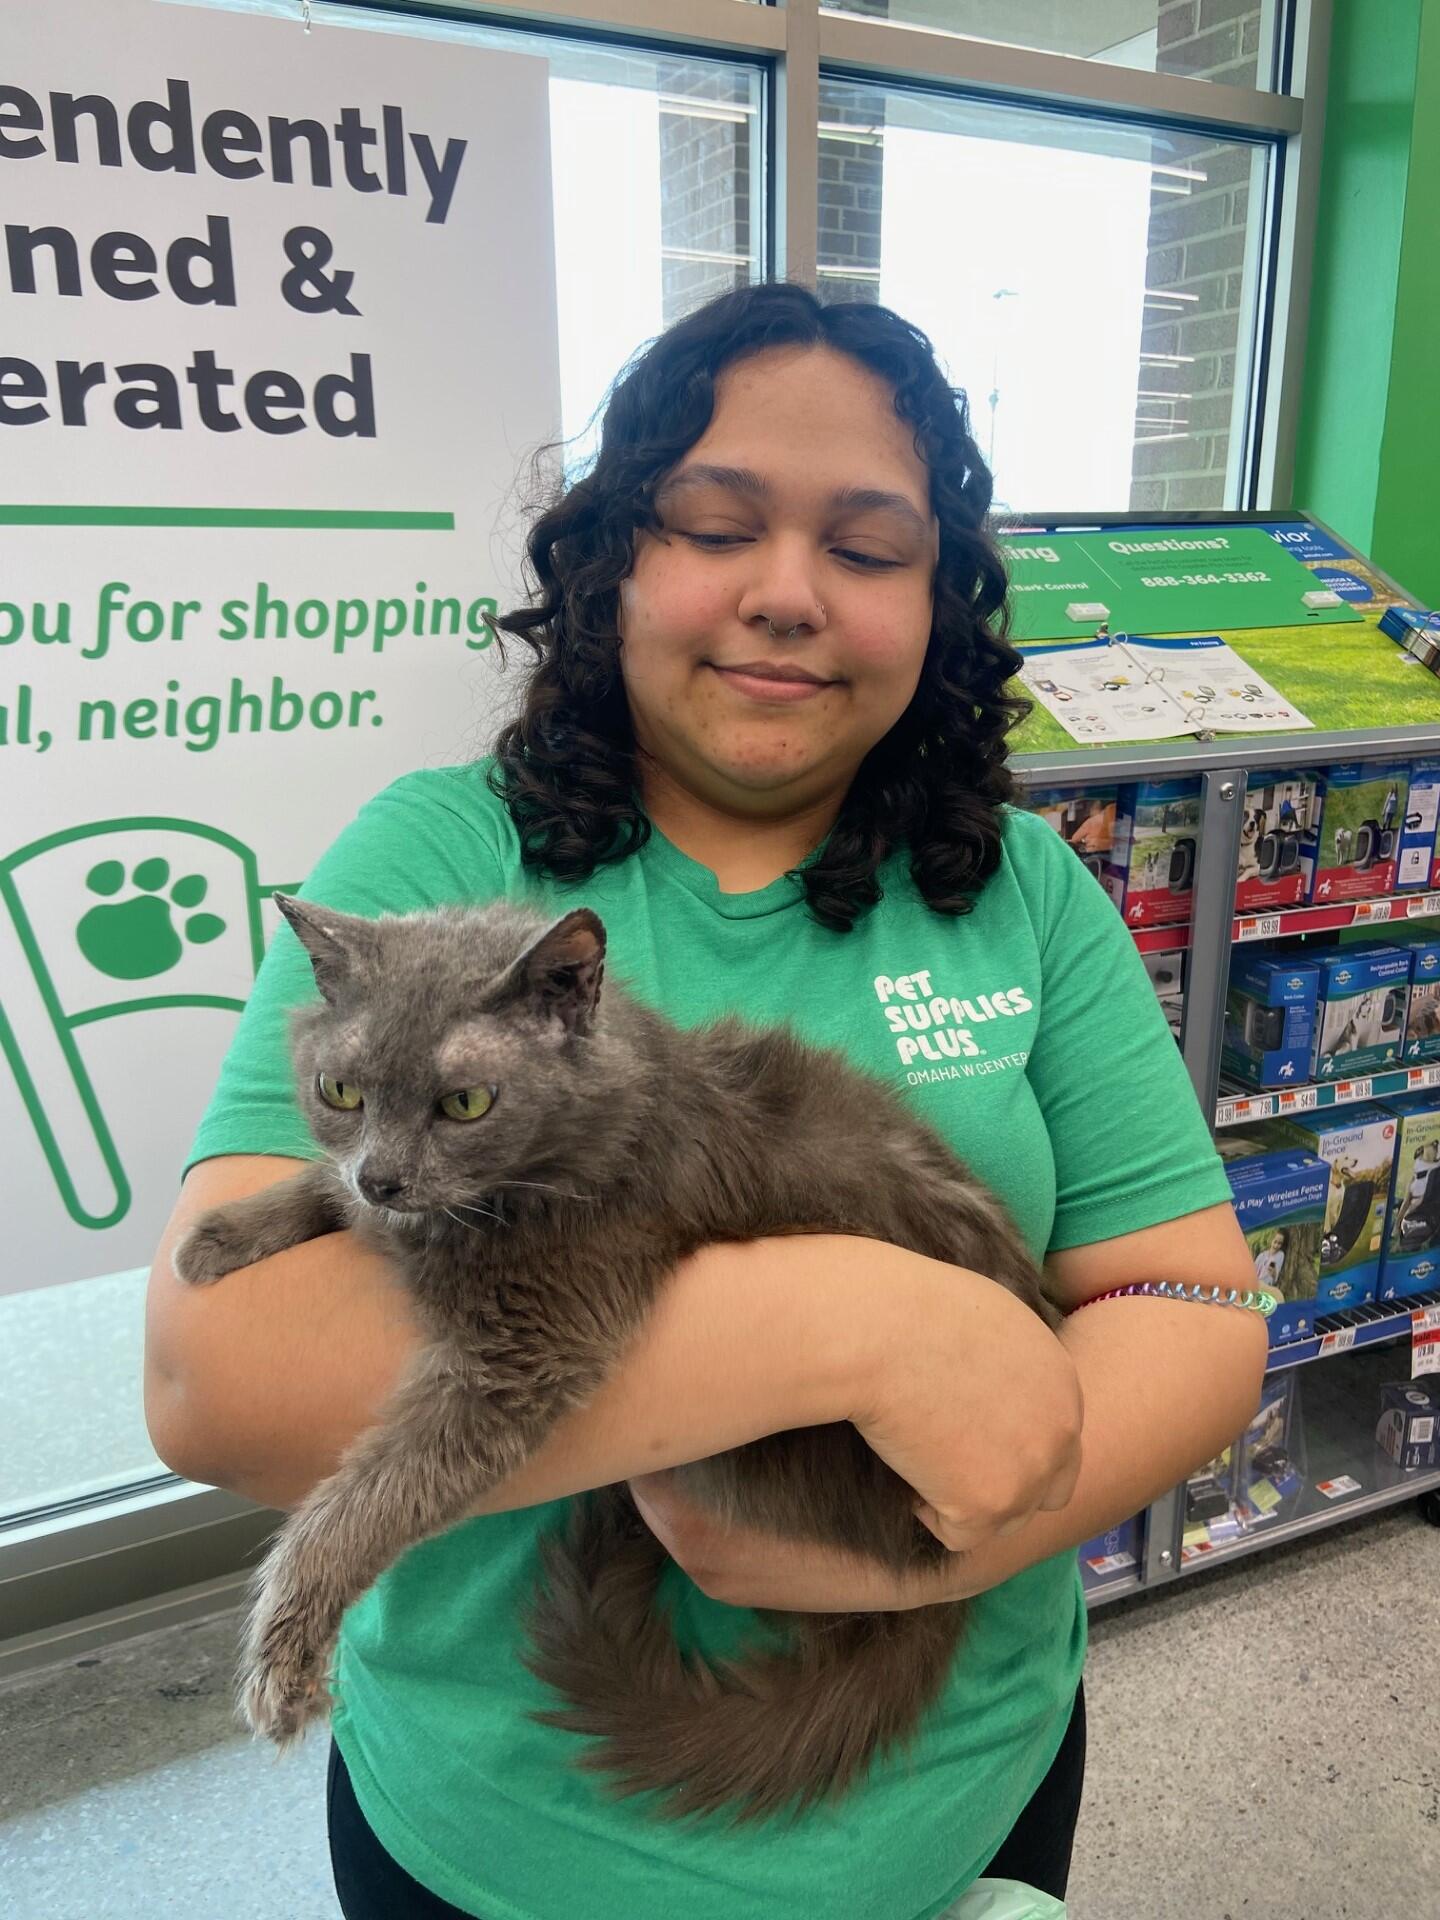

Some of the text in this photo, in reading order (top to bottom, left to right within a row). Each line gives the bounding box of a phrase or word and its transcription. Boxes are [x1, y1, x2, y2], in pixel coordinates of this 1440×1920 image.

[0, 78, 468, 224] endently
[4, 214, 363, 317] ned &
[0, 350, 377, 438] erated
[1106, 537, 1231, 556] Questions?
[1044, 581, 1089, 590] Control
[1140, 571, 1272, 588] 888-364-3362
[81, 581, 202, 659] for
[219, 581, 499, 654] shopping
[0, 676, 384, 753] l, neighbor.
[873, 970, 934, 1003] PET
[884, 987, 1033, 1033] SUPPLIES
[907, 1067, 961, 1086] OMAHA
[960, 1063, 975, 1077] W
[1321, 1145, 1346, 1157] Fence
[1322, 1130, 1364, 1150] In-Ground
[1239, 1201, 1246, 1210] &
[1267, 1187, 1299, 1204] Wireless
[1300, 1183, 1324, 1195] Fence
